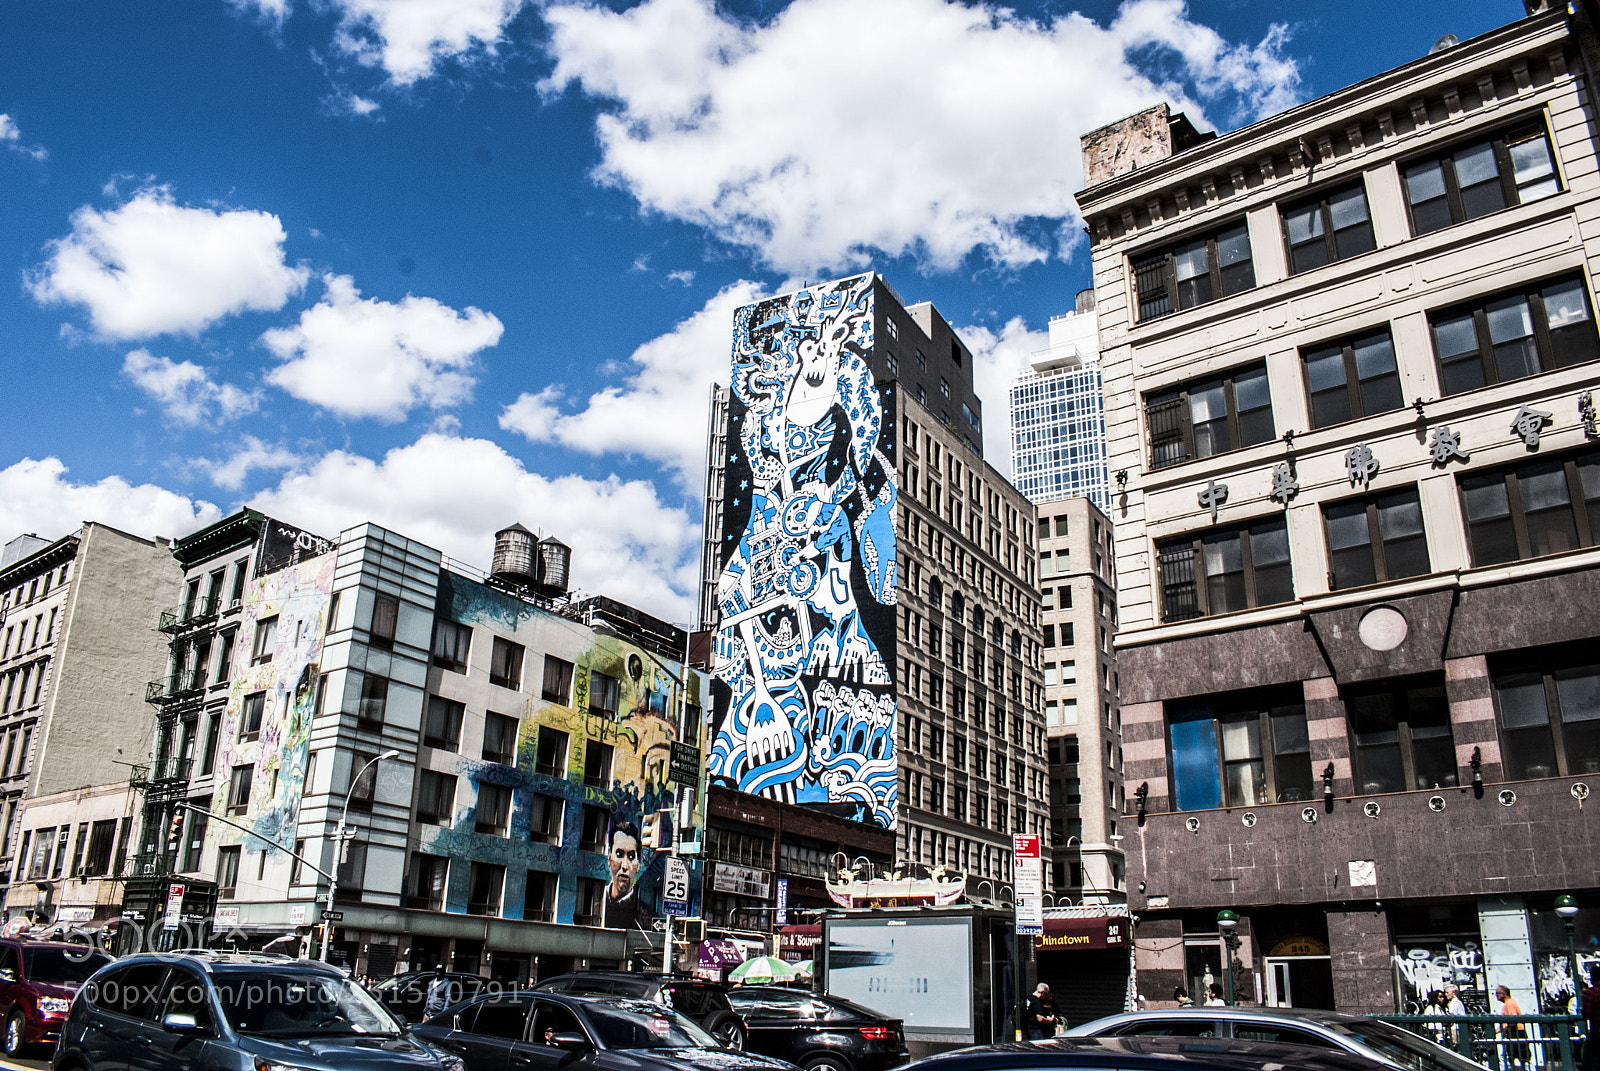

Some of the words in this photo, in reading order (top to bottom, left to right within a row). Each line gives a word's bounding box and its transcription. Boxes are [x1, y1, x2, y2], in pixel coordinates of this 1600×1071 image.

[677, 752, 699, 765] FINANCIAL
[680, 762, 699, 773] DISTRICT
[670, 867, 685, 875] SPEED
[666, 880, 685, 898] 25
[790, 934, 795, 945] &
